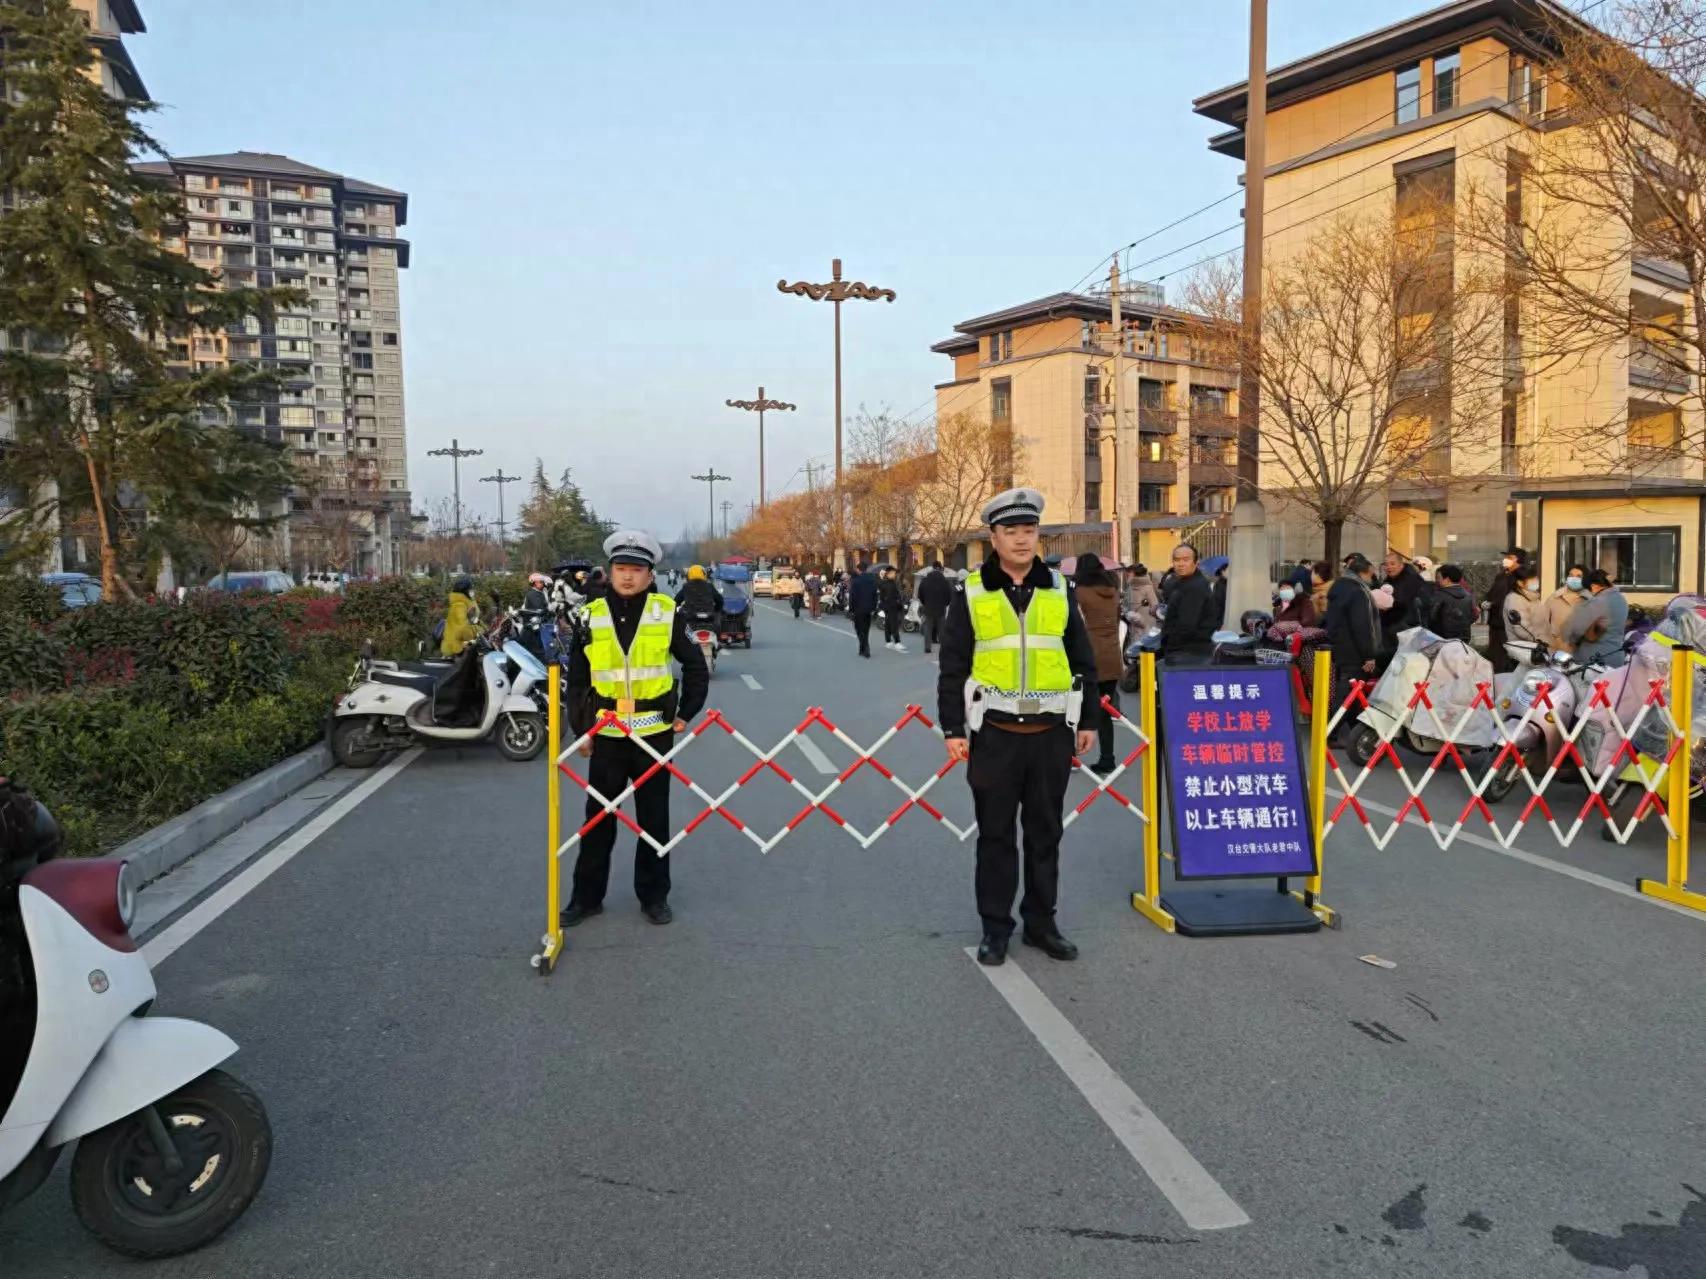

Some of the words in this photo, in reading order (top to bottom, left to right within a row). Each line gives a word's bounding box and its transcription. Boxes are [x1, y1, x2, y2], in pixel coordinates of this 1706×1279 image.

[1193, 684, 1260, 700] 温馨提示
[1187, 710, 1272, 732] 学校上放学
[1182, 742, 1284, 765] 车辆临时管控
[1185, 774, 1288, 797] 禁止小型汽车
